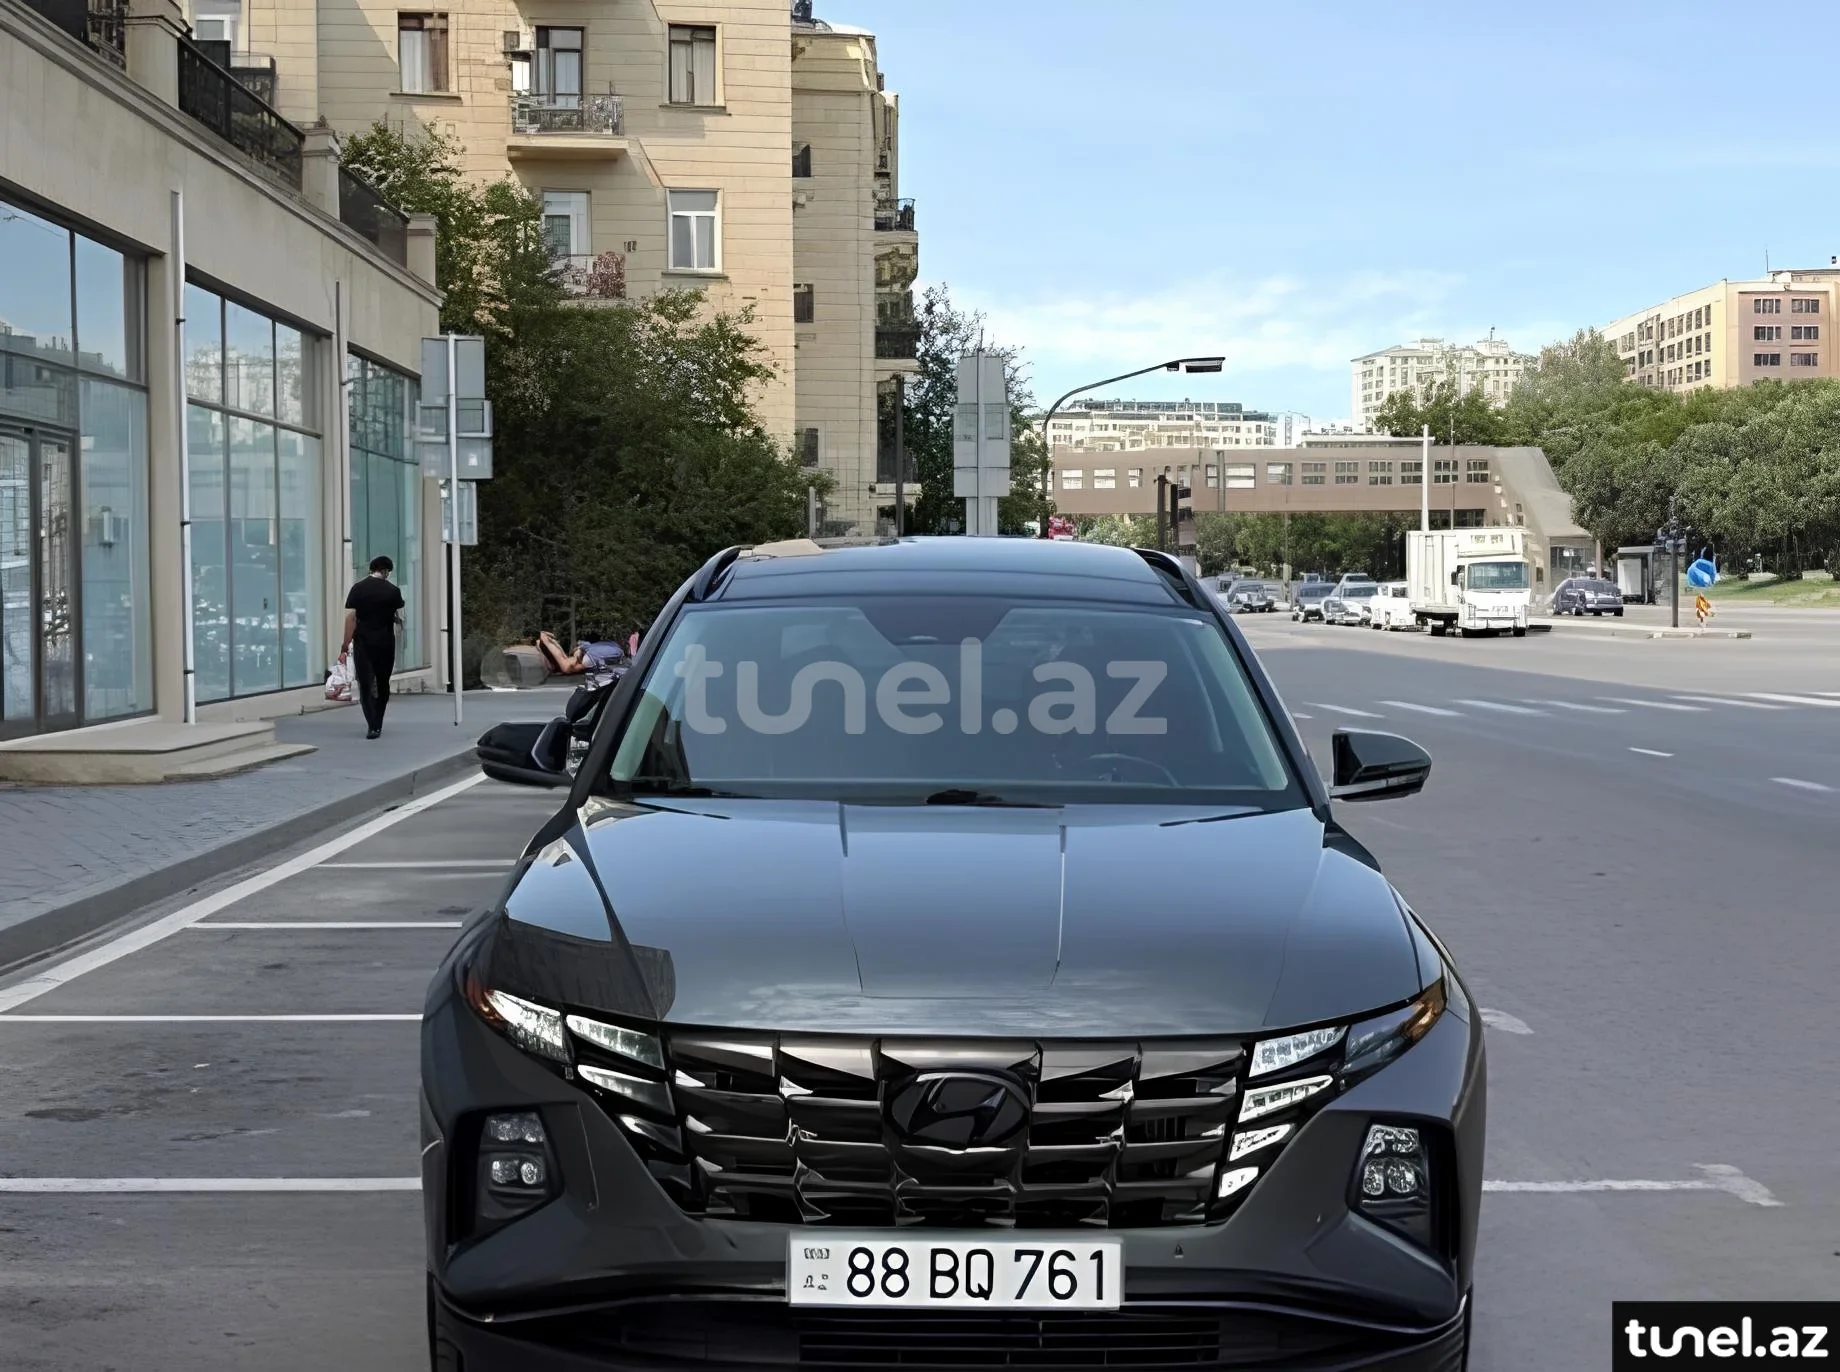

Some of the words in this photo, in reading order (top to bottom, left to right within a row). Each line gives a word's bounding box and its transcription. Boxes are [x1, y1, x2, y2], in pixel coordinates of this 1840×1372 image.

[847, 1247, 910, 1298] 88
[930, 1248, 994, 1300] BQ
[1014, 1249, 1104, 1301] 761
